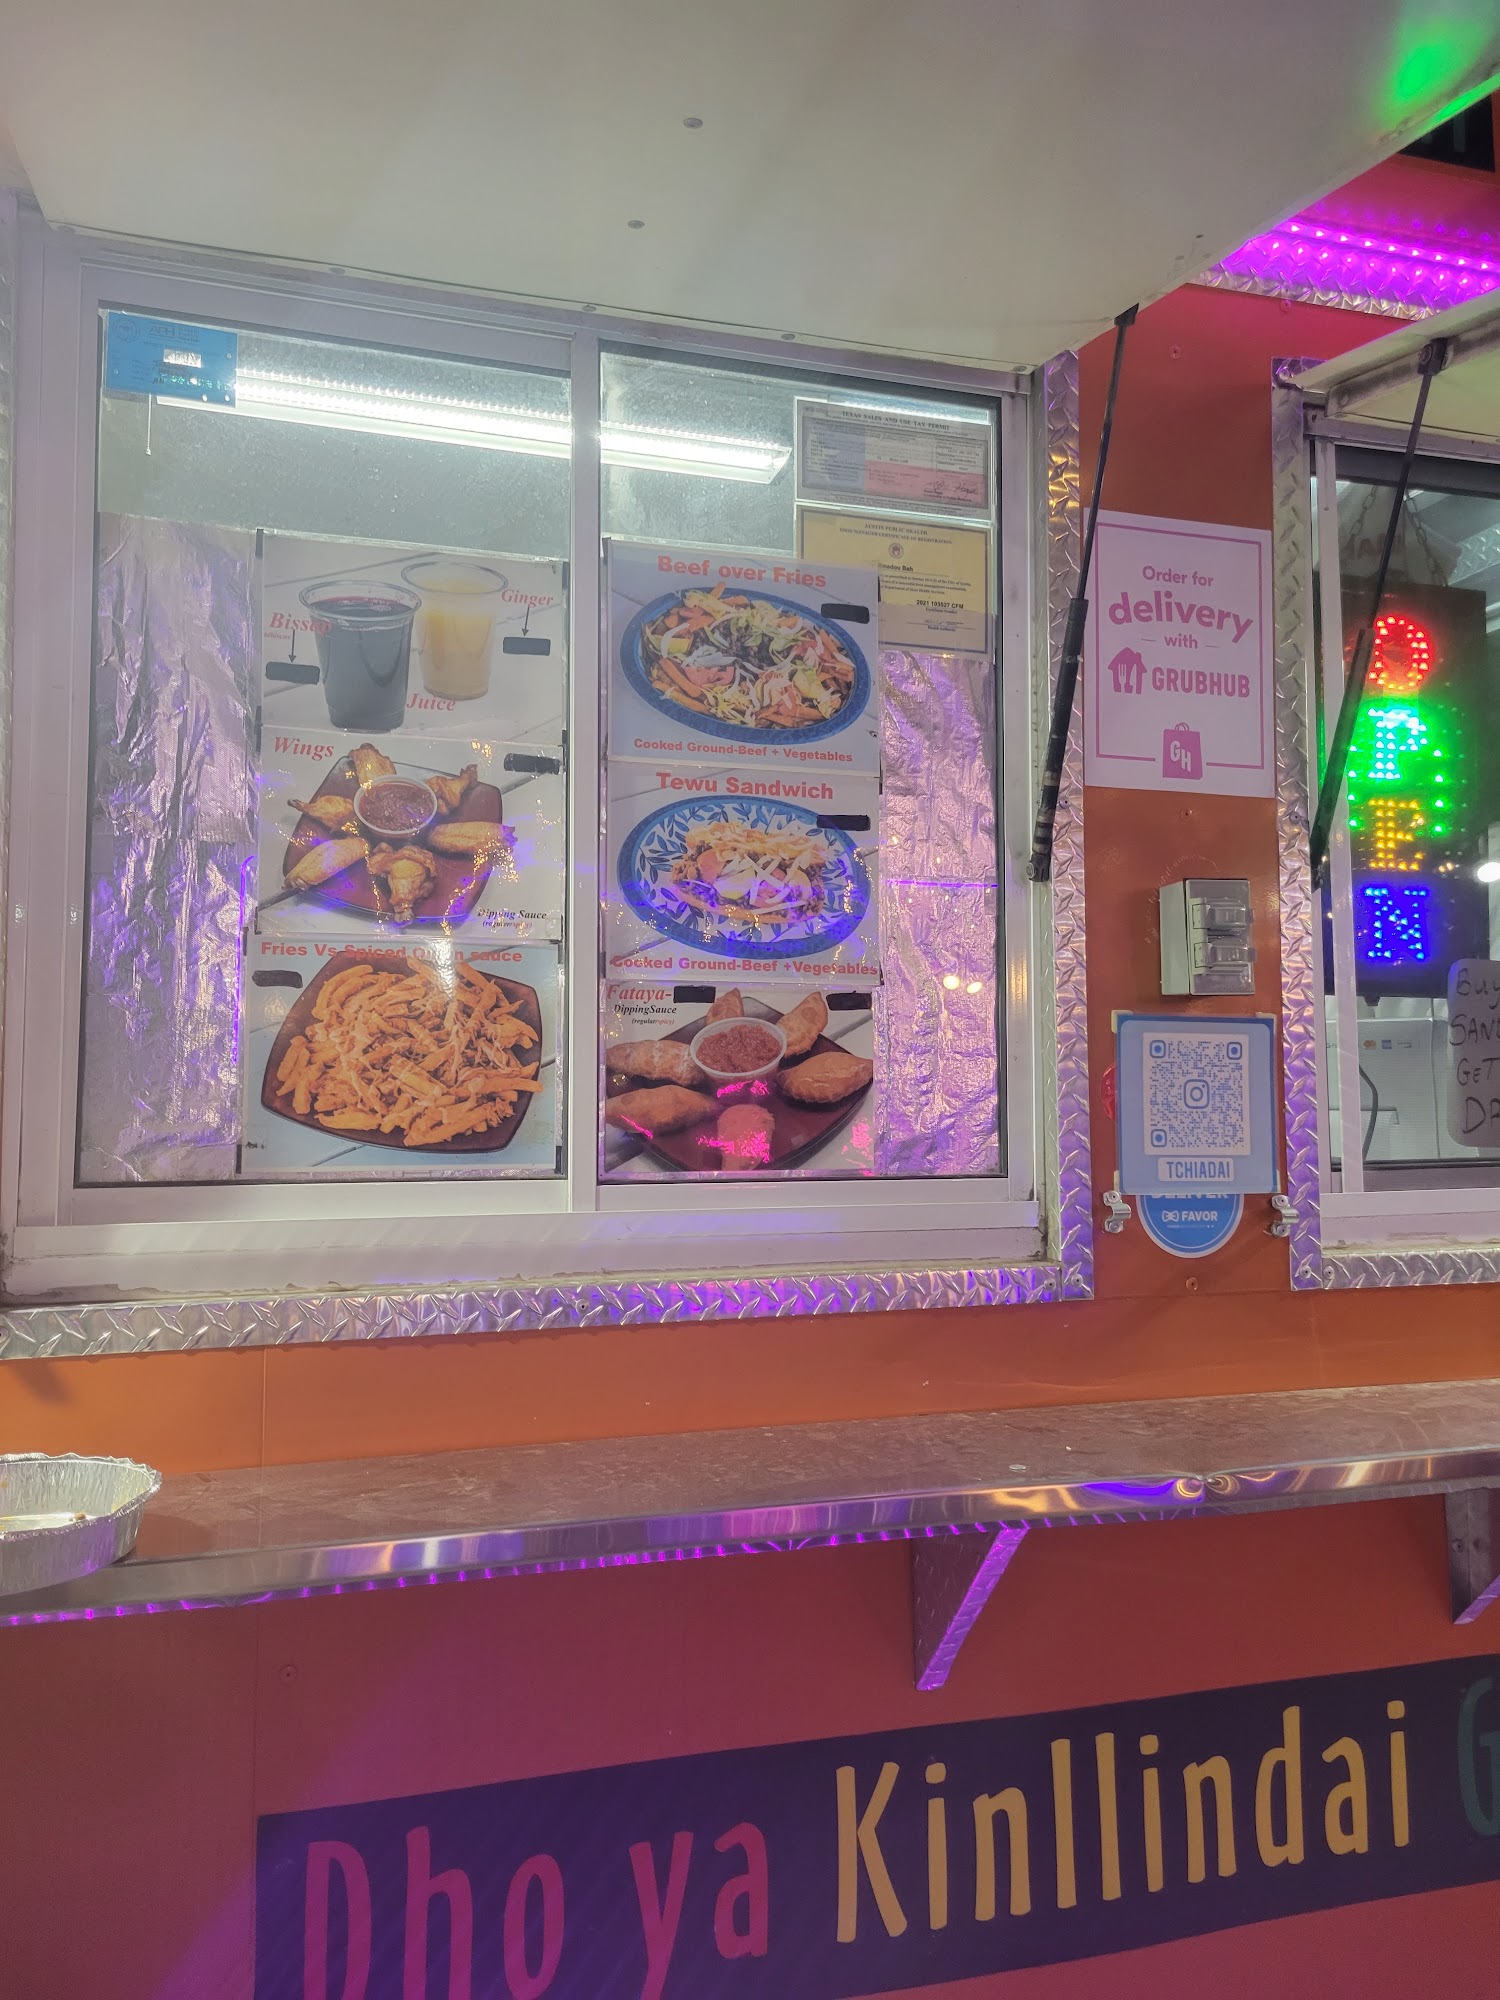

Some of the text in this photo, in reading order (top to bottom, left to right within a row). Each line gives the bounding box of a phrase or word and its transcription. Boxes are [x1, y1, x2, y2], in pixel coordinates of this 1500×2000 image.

[863, 413, 882, 421] SALES
[657, 555, 827, 588] Beef over Fries
[1142, 565, 1214, 587] Order for
[501, 588, 554, 608] Ginger
[1108, 590, 1253, 644] delivery
[1163, 633, 1198, 649] with
[1151, 666, 1250, 698] GRUBHUB
[406, 693, 456, 712] Juice
[273, 736, 335, 761] Wings
[634, 738, 853, 763] Cooked Ground-Beef + Vegetables
[656, 772, 834, 800] Tewu Sandwich
[1366, 613, 1432, 961] OPEN
[518, 909, 547, 920] Sauce
[261, 942, 307, 957] Fries
[313, 943, 337, 958] Vs
[343, 944, 406, 960] Spiced
[470, 950, 522, 962] sauce
[611, 956, 673, 970] Cooked
[678, 957, 778, 973] Ground-Beef
[632, 1018, 675, 1026] (regular/spicy)
[1449, 1013, 1500, 1046] SAN
[1166, 1161, 1231, 1180] TCHIADAI
[1181, 1210, 1218, 1222] FAVOR
[303, 1825, 565, 2000] Dho
[628, 1821, 769, 2000] ya
[836, 1700, 1409, 1943] Kinllindai
